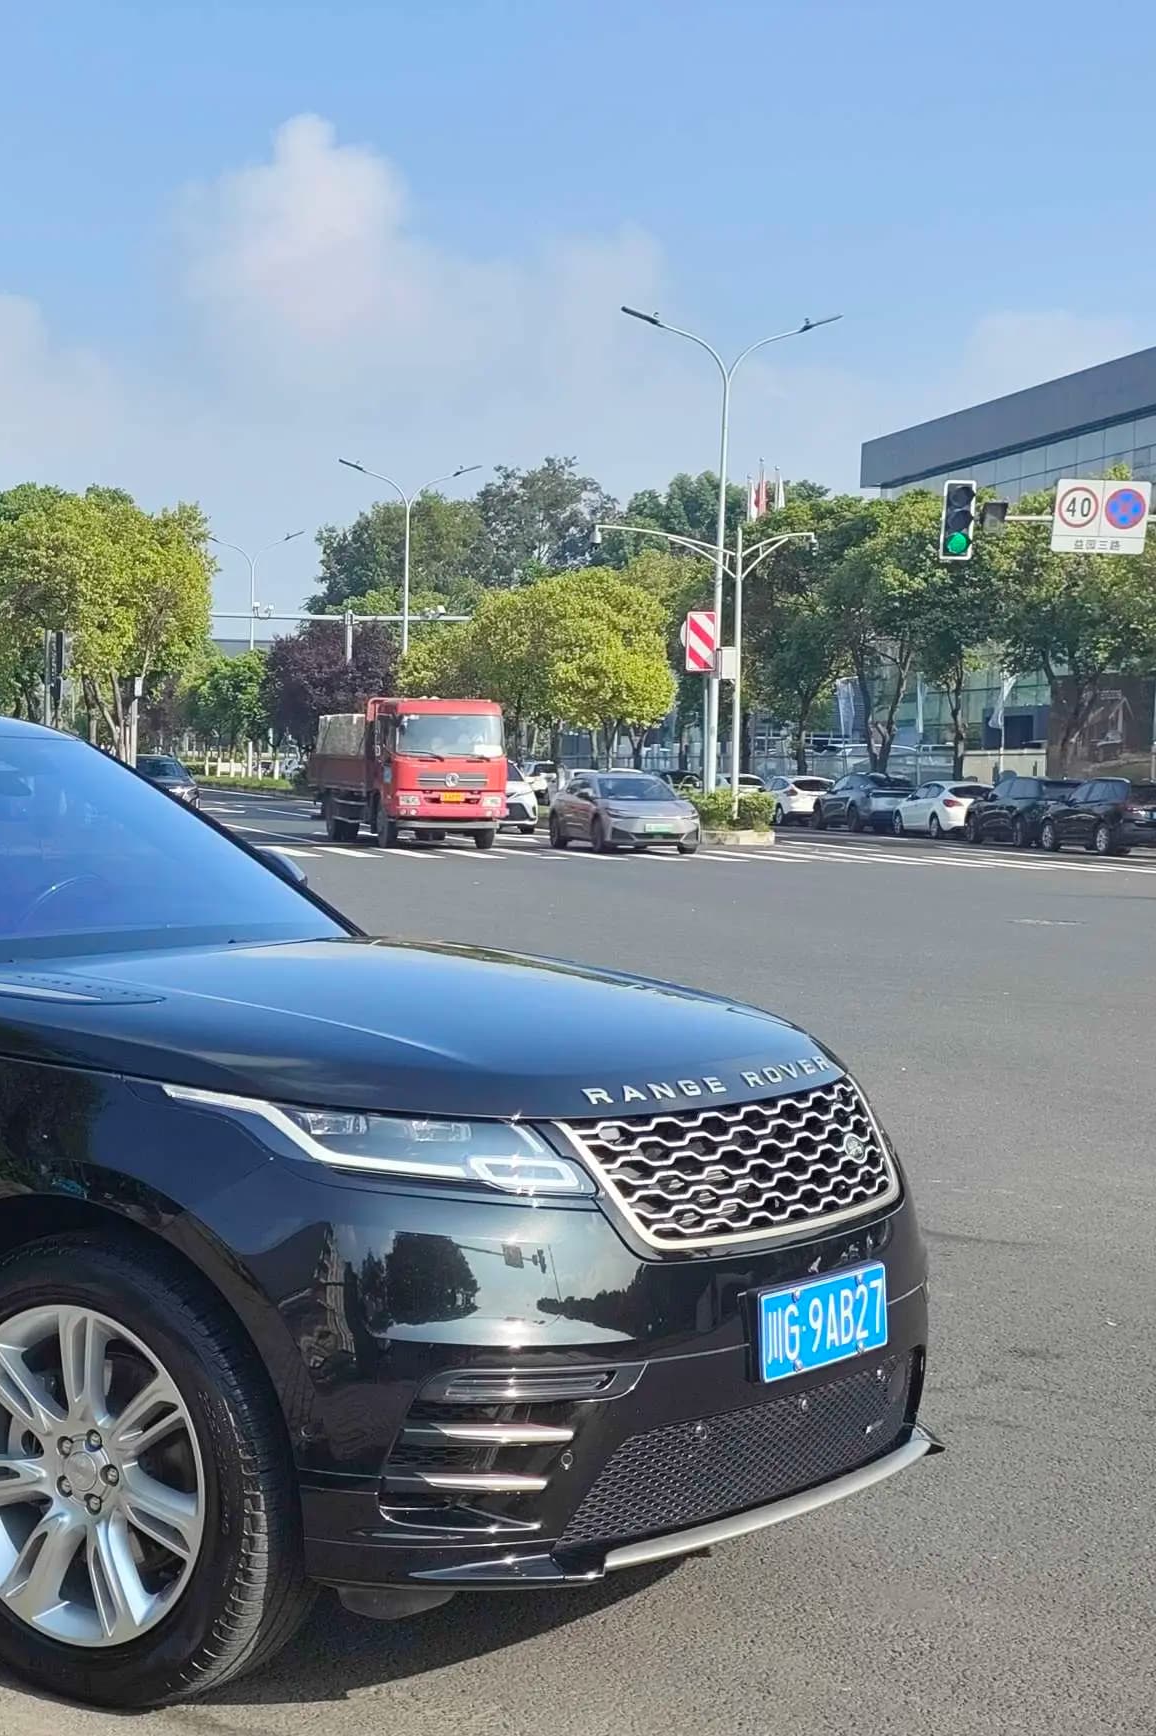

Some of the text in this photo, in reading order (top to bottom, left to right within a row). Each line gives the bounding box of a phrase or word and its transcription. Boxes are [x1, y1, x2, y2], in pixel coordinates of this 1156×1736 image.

[1066, 497, 1091, 517] 40
[580, 1054, 831, 1106] RANGE ROVER
